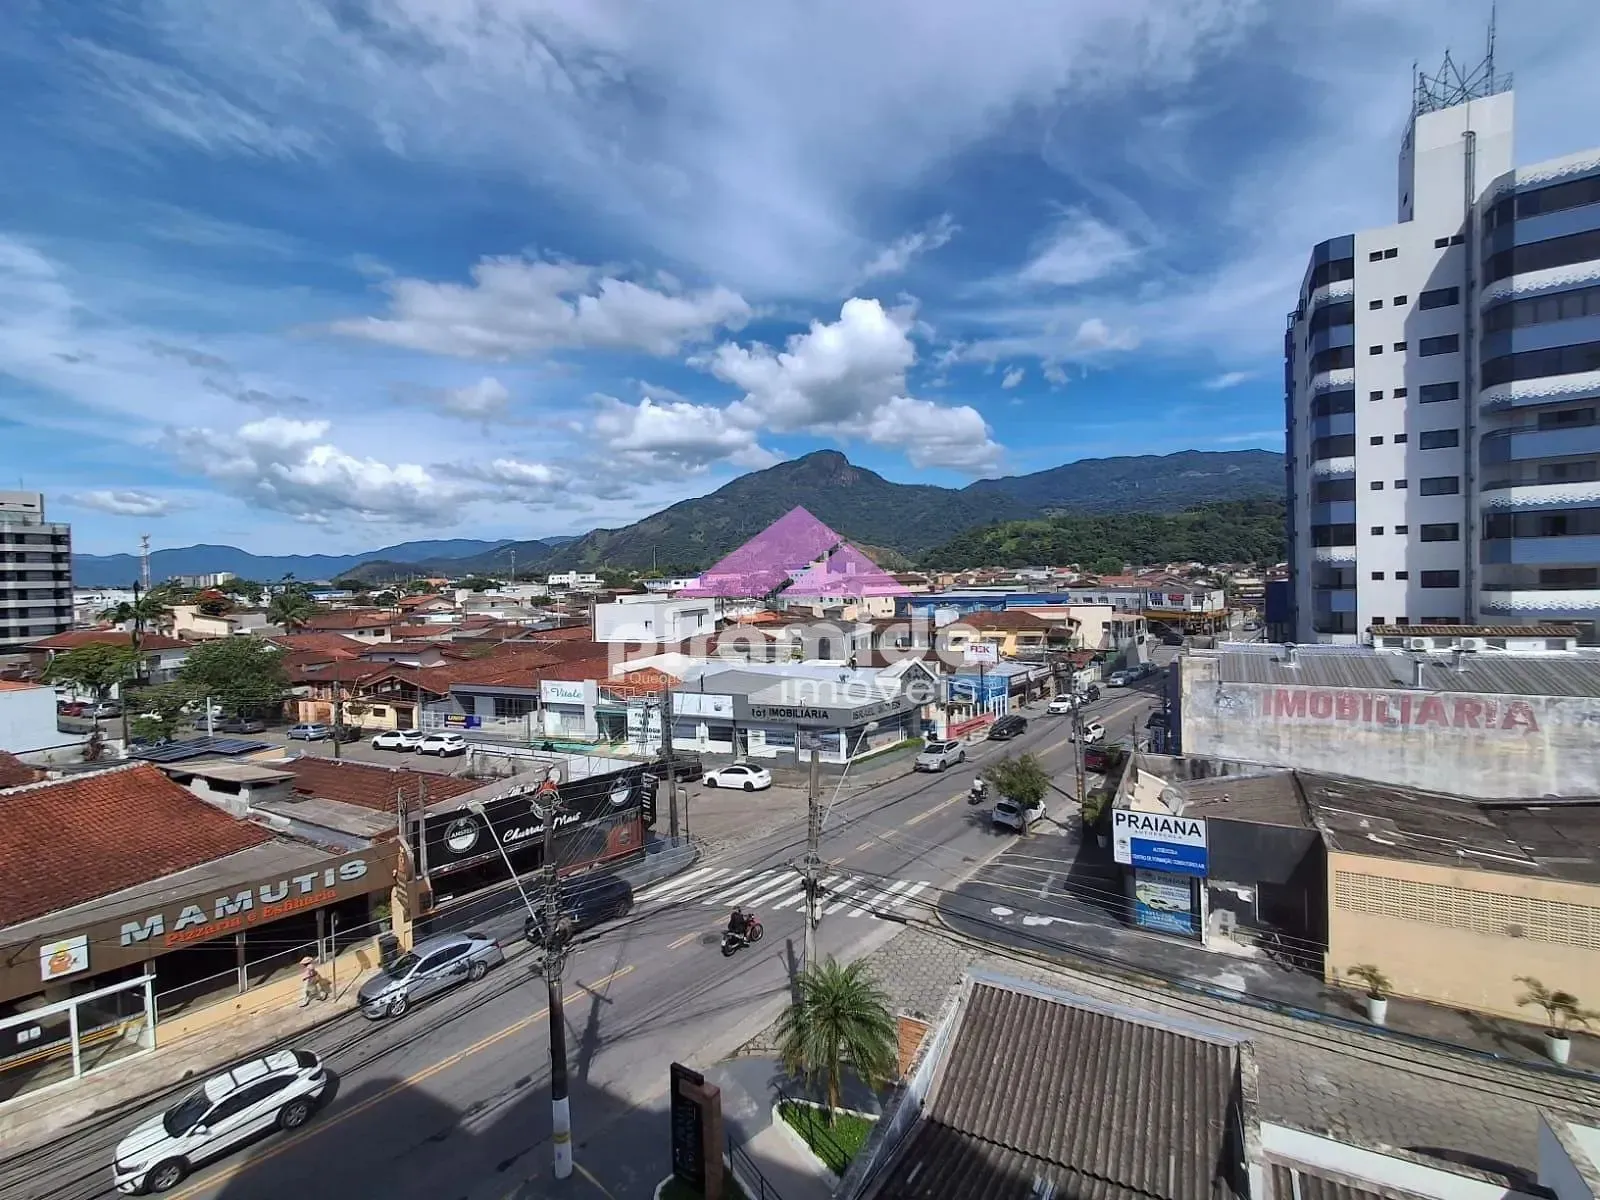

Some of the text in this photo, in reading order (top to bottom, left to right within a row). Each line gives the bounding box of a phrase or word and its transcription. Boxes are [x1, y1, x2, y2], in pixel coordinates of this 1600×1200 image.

[1115, 812, 1202, 838] PRAIANA
[120, 859, 368, 947] MAMUTIS
[165, 916, 242, 947] Pizzaria
[247, 911, 257, 922] e
